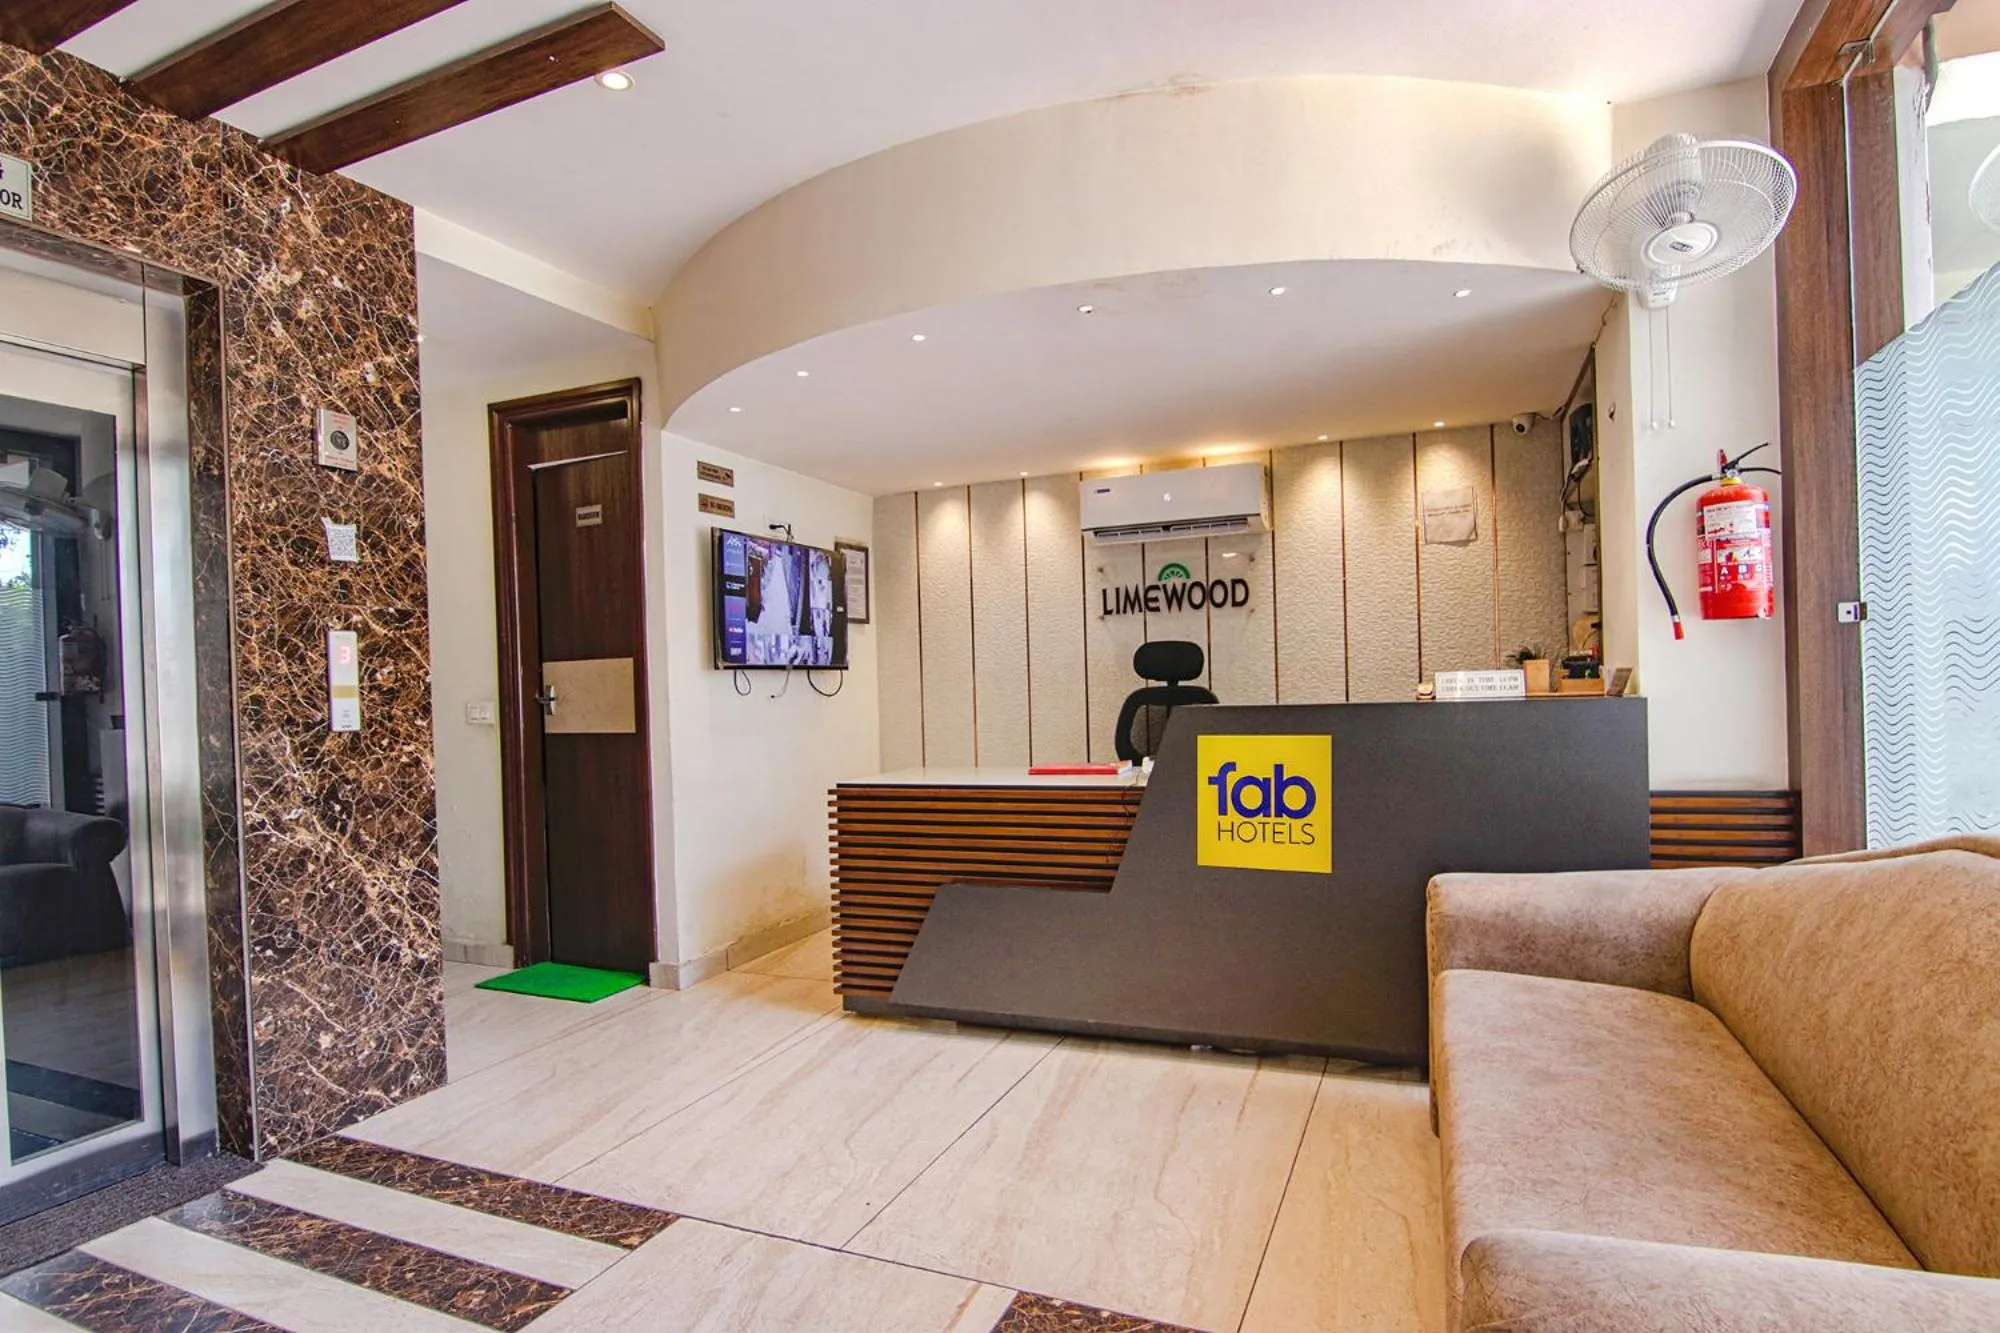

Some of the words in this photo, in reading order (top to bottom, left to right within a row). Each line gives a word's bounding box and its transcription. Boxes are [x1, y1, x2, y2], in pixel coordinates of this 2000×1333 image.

[1102, 578, 1250, 616] LIMEWOOD
[339, 645, 351, 664] 3
[1207, 761, 1317, 820] fab
[1217, 820, 1316, 846] HOTELS
